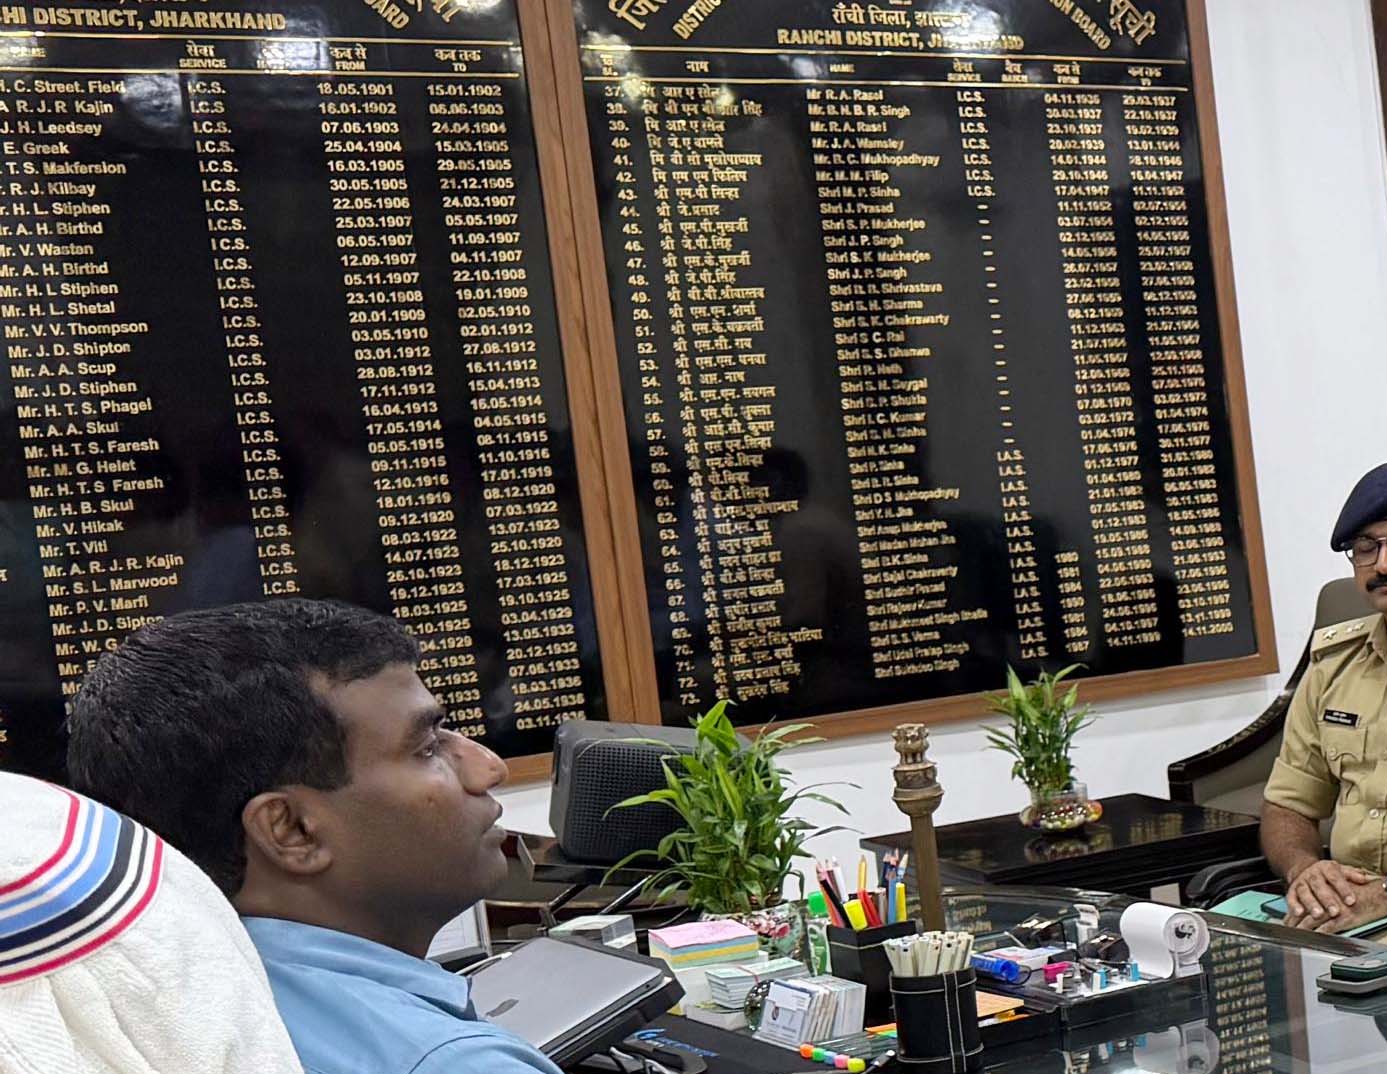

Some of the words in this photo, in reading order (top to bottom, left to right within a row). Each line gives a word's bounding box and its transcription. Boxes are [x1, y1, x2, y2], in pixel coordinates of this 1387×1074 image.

[34, 7, 143, 31] DISTRICT,
[150, 10, 287, 31] JHARKHAND
[1071, 7, 1111, 50] BOARD
[778, 29, 842, 46] RANCHI
[846, 30, 924, 50] DISTRICT,
[186, 41, 214, 57] सेवा
[180, 58, 227, 69] SERVICE
[336, 61, 365, 71] FROM
[453, 63, 467, 72] TO
[14, 80, 31, 92] C.
[317, 83, 393, 95] 18.05.1901
[427, 85, 501, 96] 15.01.1902
[75, 100, 113, 116] Kajin
[321, 121, 399, 133] 07.06.1903
[23, 142, 70, 154] Greek
[327, 160, 404, 171] 16.03.1905
[614, 155, 633, 165] 41.
[616, 172, 636, 182] 42.
[443, 196, 515, 207] 24.03.1907
[618, 189, 637, 200] 43.
[52, 202, 110, 217] Stiphen
[333, 197, 410, 209] 22.05.1906
[445, 214, 518, 226] 05.05.1907
[623, 223, 642, 234] 45.
[337, 234, 413, 247] 06.05.1907
[451, 250, 522, 263] 04.11.1907
[627, 258, 646, 268] 47.
[344, 272, 419, 285] 05.11.1907
[61, 282, 118, 297] Stiphen
[456, 287, 528, 300] 19.01.1909
[1, 305, 25, 317] Mr.
[29, 304, 45, 316] H.
[49, 303, 64, 315] L.
[68, 301, 115, 315] Shetal
[349, 309, 425, 323] 20.01.1909
[633, 309, 653, 320] 50.
[5, 326, 28, 338] Mr.
[31, 324, 47, 336] V.
[49, 323, 64, 336] V.
[67, 323, 148, 336] Thompson
[460, 323, 533, 337] 02.01.1912
[635, 326, 654, 337] 51.
[73, 342, 131, 356] Shipton
[355, 346, 431, 360] 03.01.1912
[638, 343, 657, 353] 52.
[11, 365, 35, 378] Mr.
[38, 364, 54, 376] A.
[58, 363, 74, 375] A.
[78, 362, 116, 375] Scup
[466, 359, 537, 373] 16.11.1912
[640, 359, 659, 370] 53.
[80, 381, 137, 396] Stiphen
[360, 383, 436, 397] 17.11.1912
[468, 377, 540, 391] 15.04.1913
[17, 405, 41, 418] Mr.
[45, 404, 61, 417] H.
[64, 403, 78, 415] T.
[82, 402, 97, 414] S.
[366, 419, 442, 435] 17.05.1914
[474, 413, 546, 428] 04.05.1915
[107, 438, 159, 453] Faresh
[479, 448, 550, 463] 11.10.1916
[371, 456, 446, 472] 09.11.1915
[113, 476, 164, 492] Faresh
[376, 492, 451, 508] 18.01.1919
[33, 505, 57, 518] Mr.
[60, 503, 77, 516] H.
[81, 502, 97, 514] B.
[486, 501, 558, 517] 07.03.1922
[382, 528, 457, 546] 08.03.1922
[146, 554, 183, 569] Kajin
[387, 564, 462, 582] 26.10.1923
[496, 571, 567, 588] 17.03.1925
[46, 584, 69, 597] Mr.
[73, 582, 89, 594] S.
[92, 580, 106, 592] L.
[110, 573, 177, 590] Marwood
[499, 589, 570, 606] 19.10.1925
[392, 600, 467, 618] 18.03.1925
[504, 624, 574, 642] 13.05.1932
